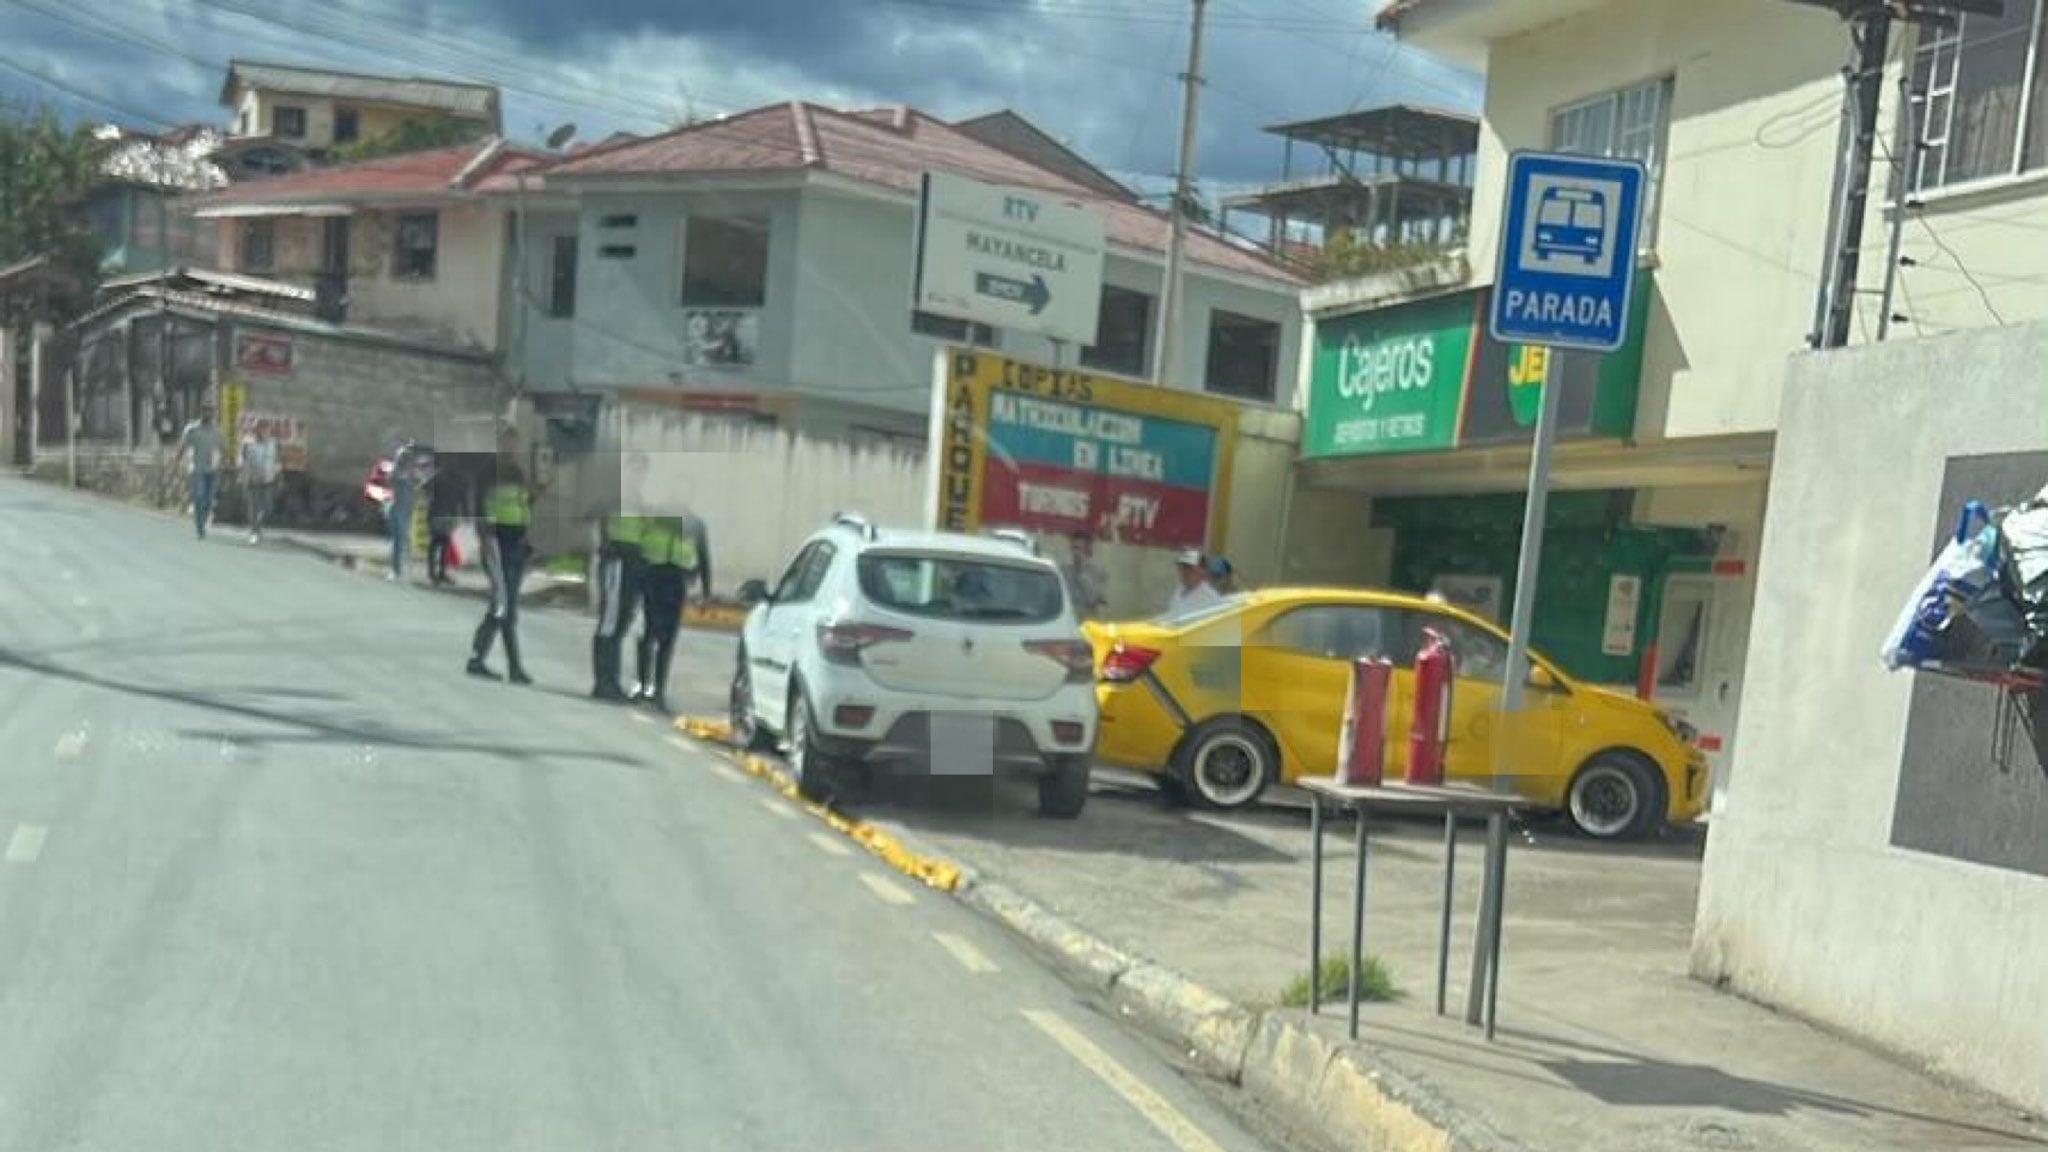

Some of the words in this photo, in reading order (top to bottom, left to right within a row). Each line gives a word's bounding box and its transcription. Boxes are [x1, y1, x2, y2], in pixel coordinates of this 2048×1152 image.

[1003, 195, 1040, 222] RTV
[1505, 290, 1613, 328] PARADA
[1002, 358, 1092, 400] COPIAS
[1337, 329, 1435, 411] Cajeros
[1508, 345, 1546, 385] JE
[1073, 440, 1098, 471] EN
[1108, 446, 1163, 481] LINEA
[1019, 481, 1091, 519] TURNOS
